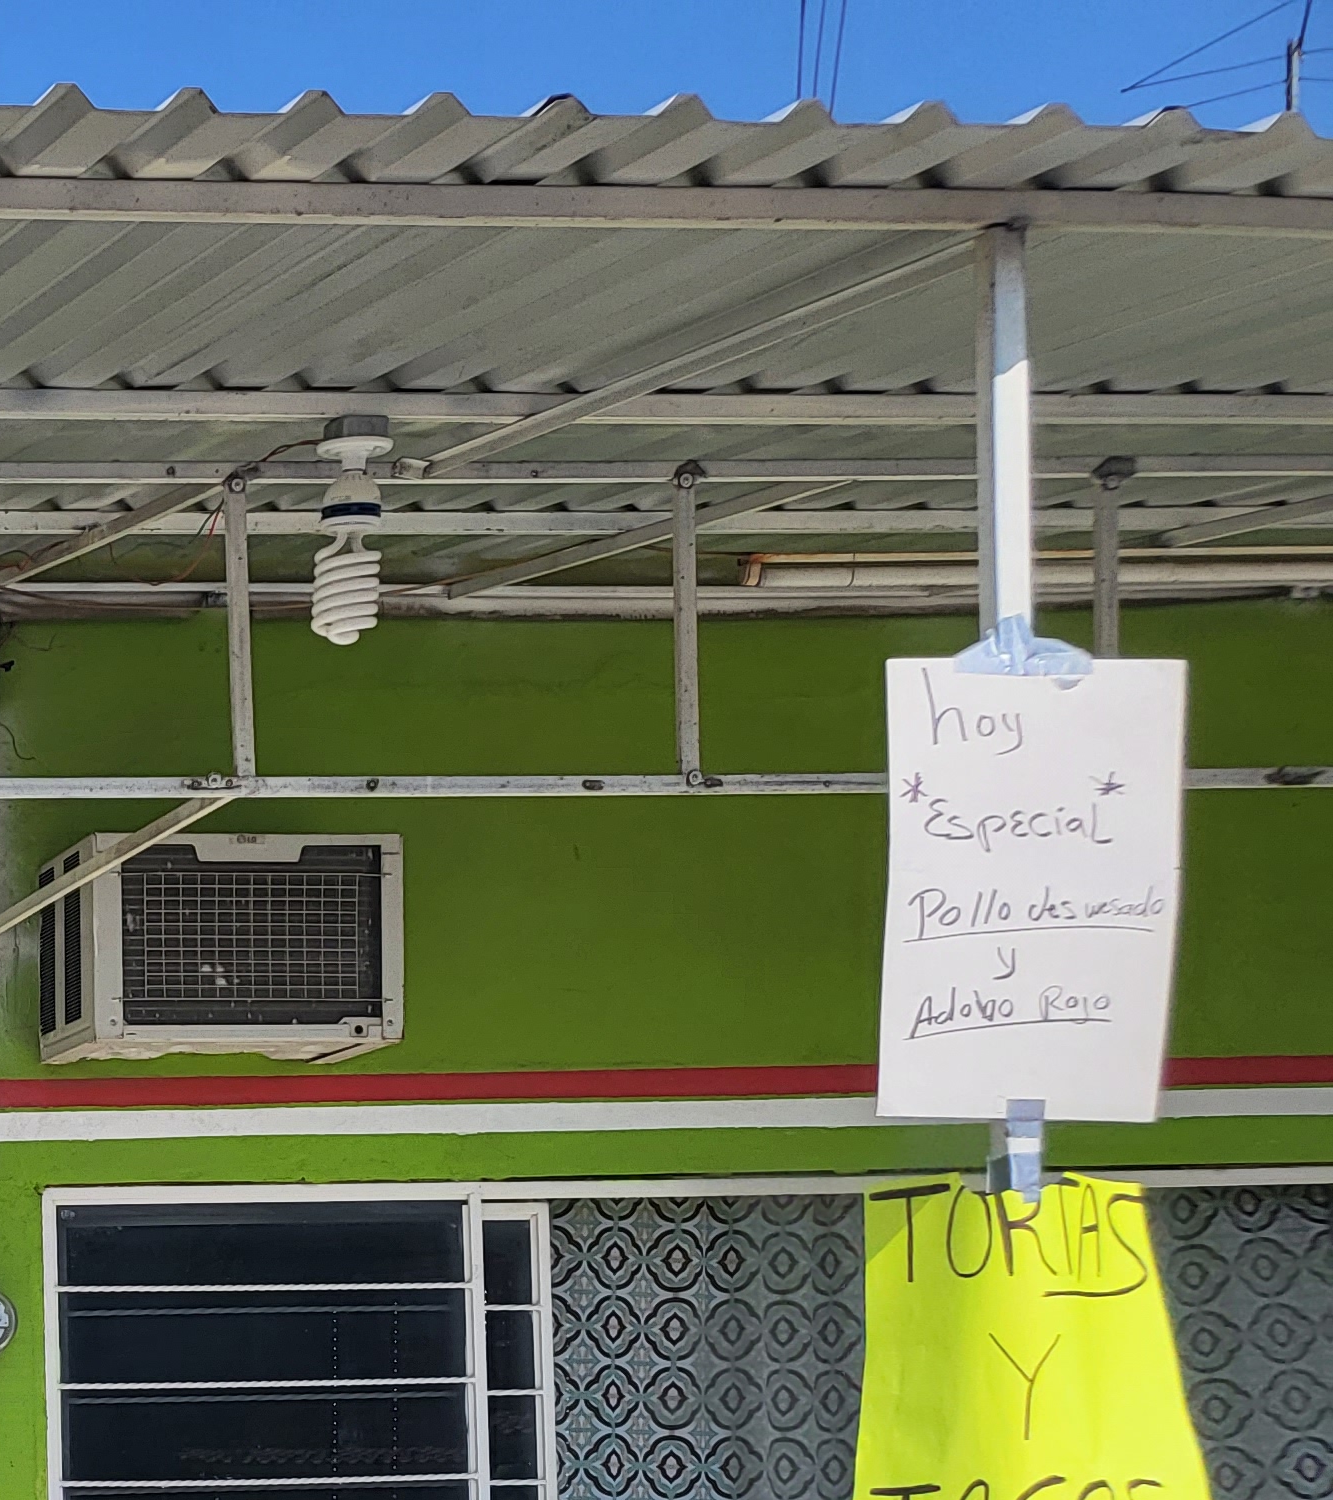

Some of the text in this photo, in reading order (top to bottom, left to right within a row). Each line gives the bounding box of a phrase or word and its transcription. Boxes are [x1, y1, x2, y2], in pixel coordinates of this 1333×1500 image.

[921, 668, 1025, 756] hoy
[907, 887, 1011, 940] Pollo
[910, 985, 1111, 1040] Adobo Rojo
[869, 1176, 1149, 1298] TORTAS
[989, 1333, 1061, 1441] Y
